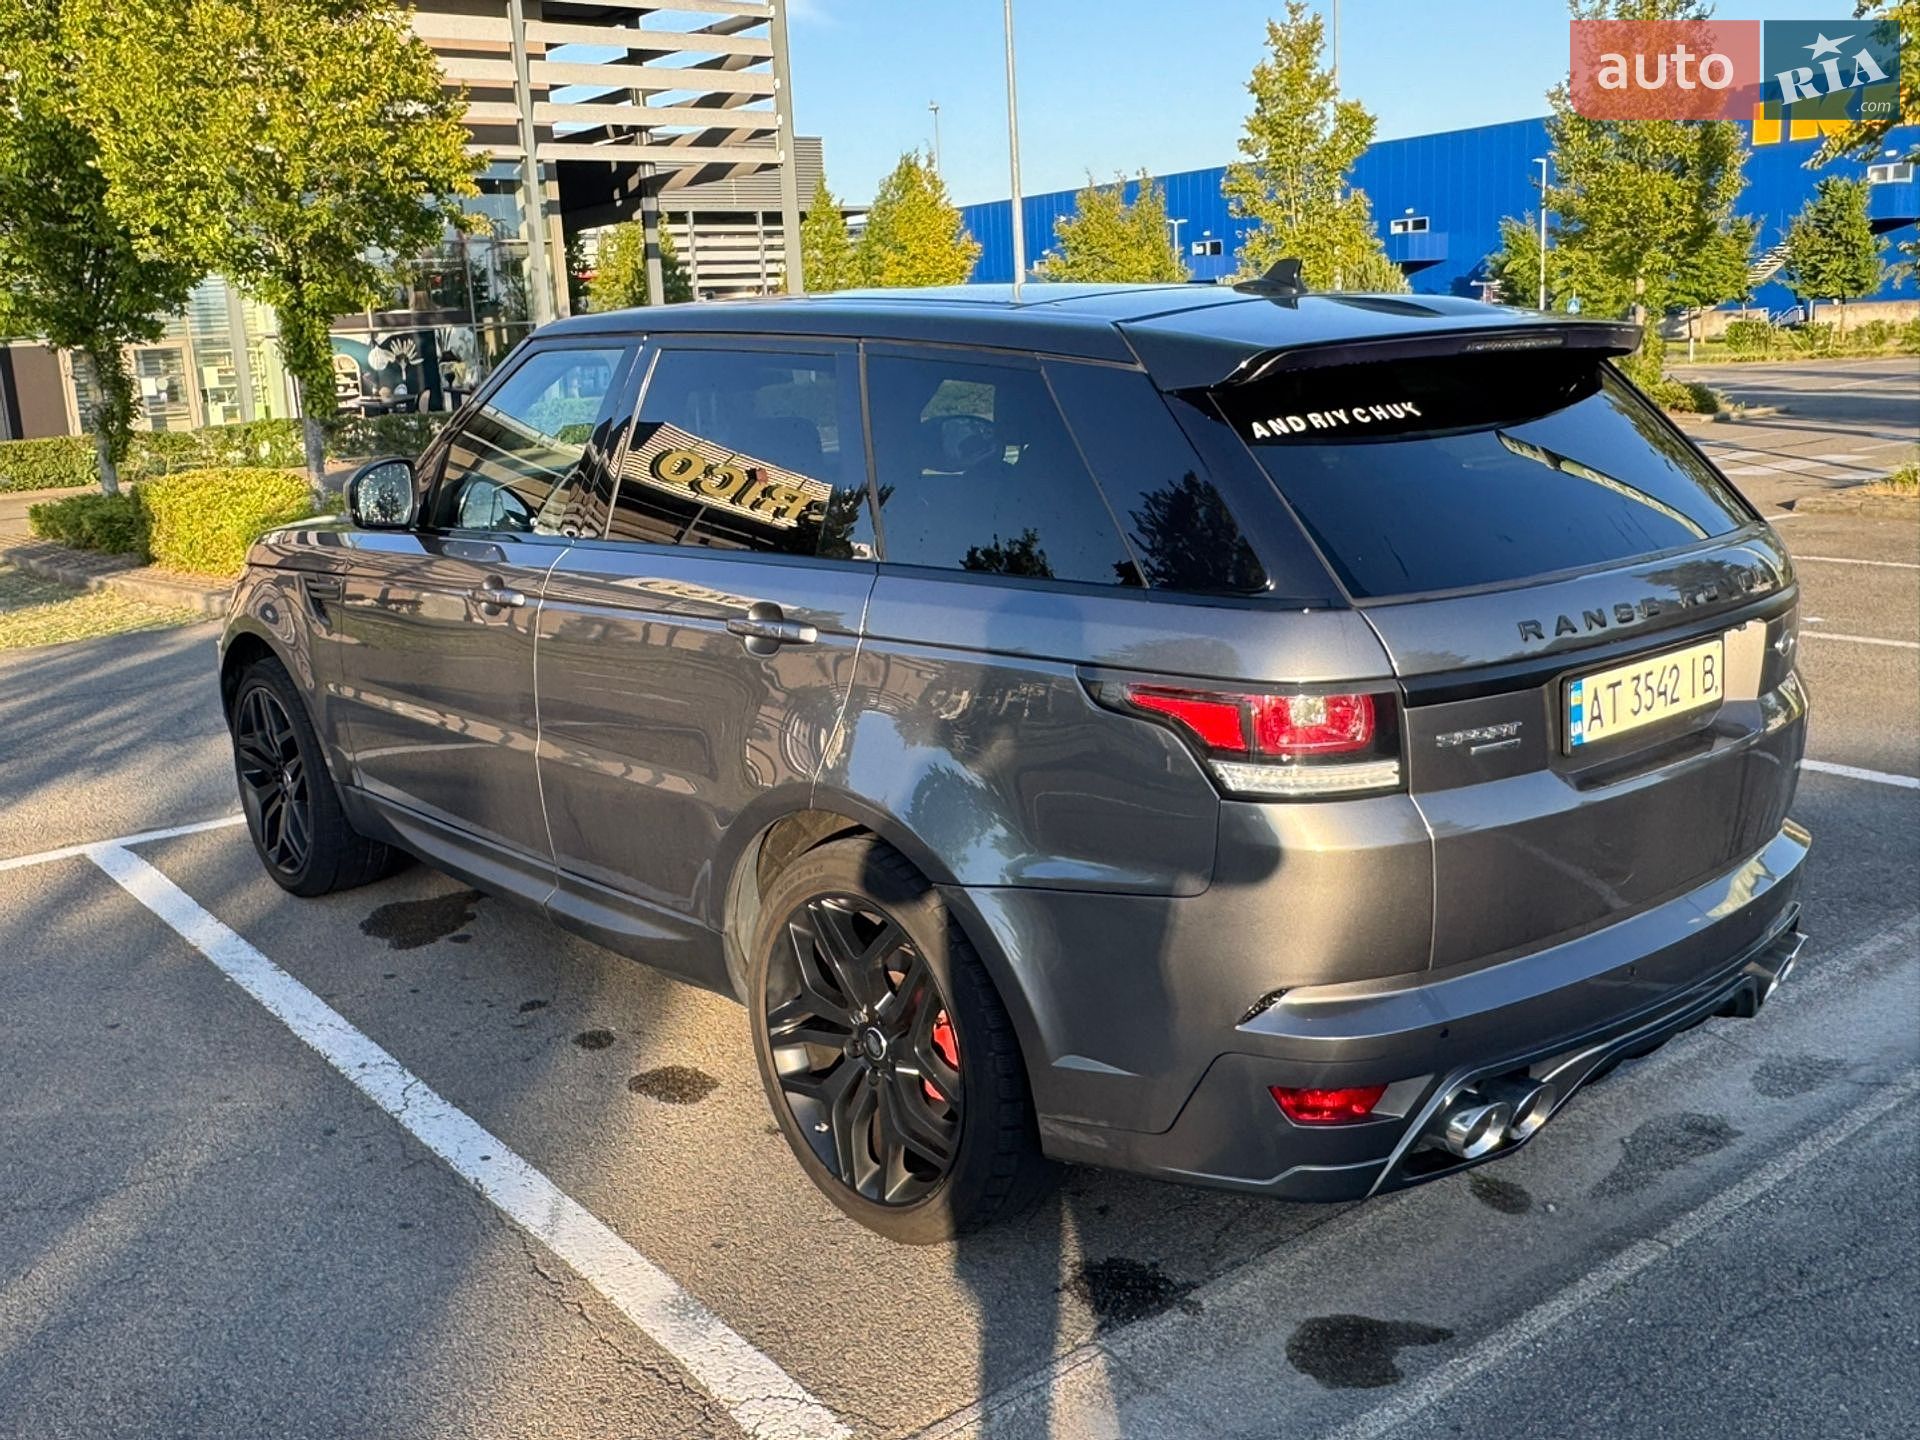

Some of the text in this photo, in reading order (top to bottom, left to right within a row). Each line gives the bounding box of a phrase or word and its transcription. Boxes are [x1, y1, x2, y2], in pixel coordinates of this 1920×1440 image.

[1517, 597, 1661, 642] RANGE
[1587, 654, 1715, 732] AT 3542 IB
